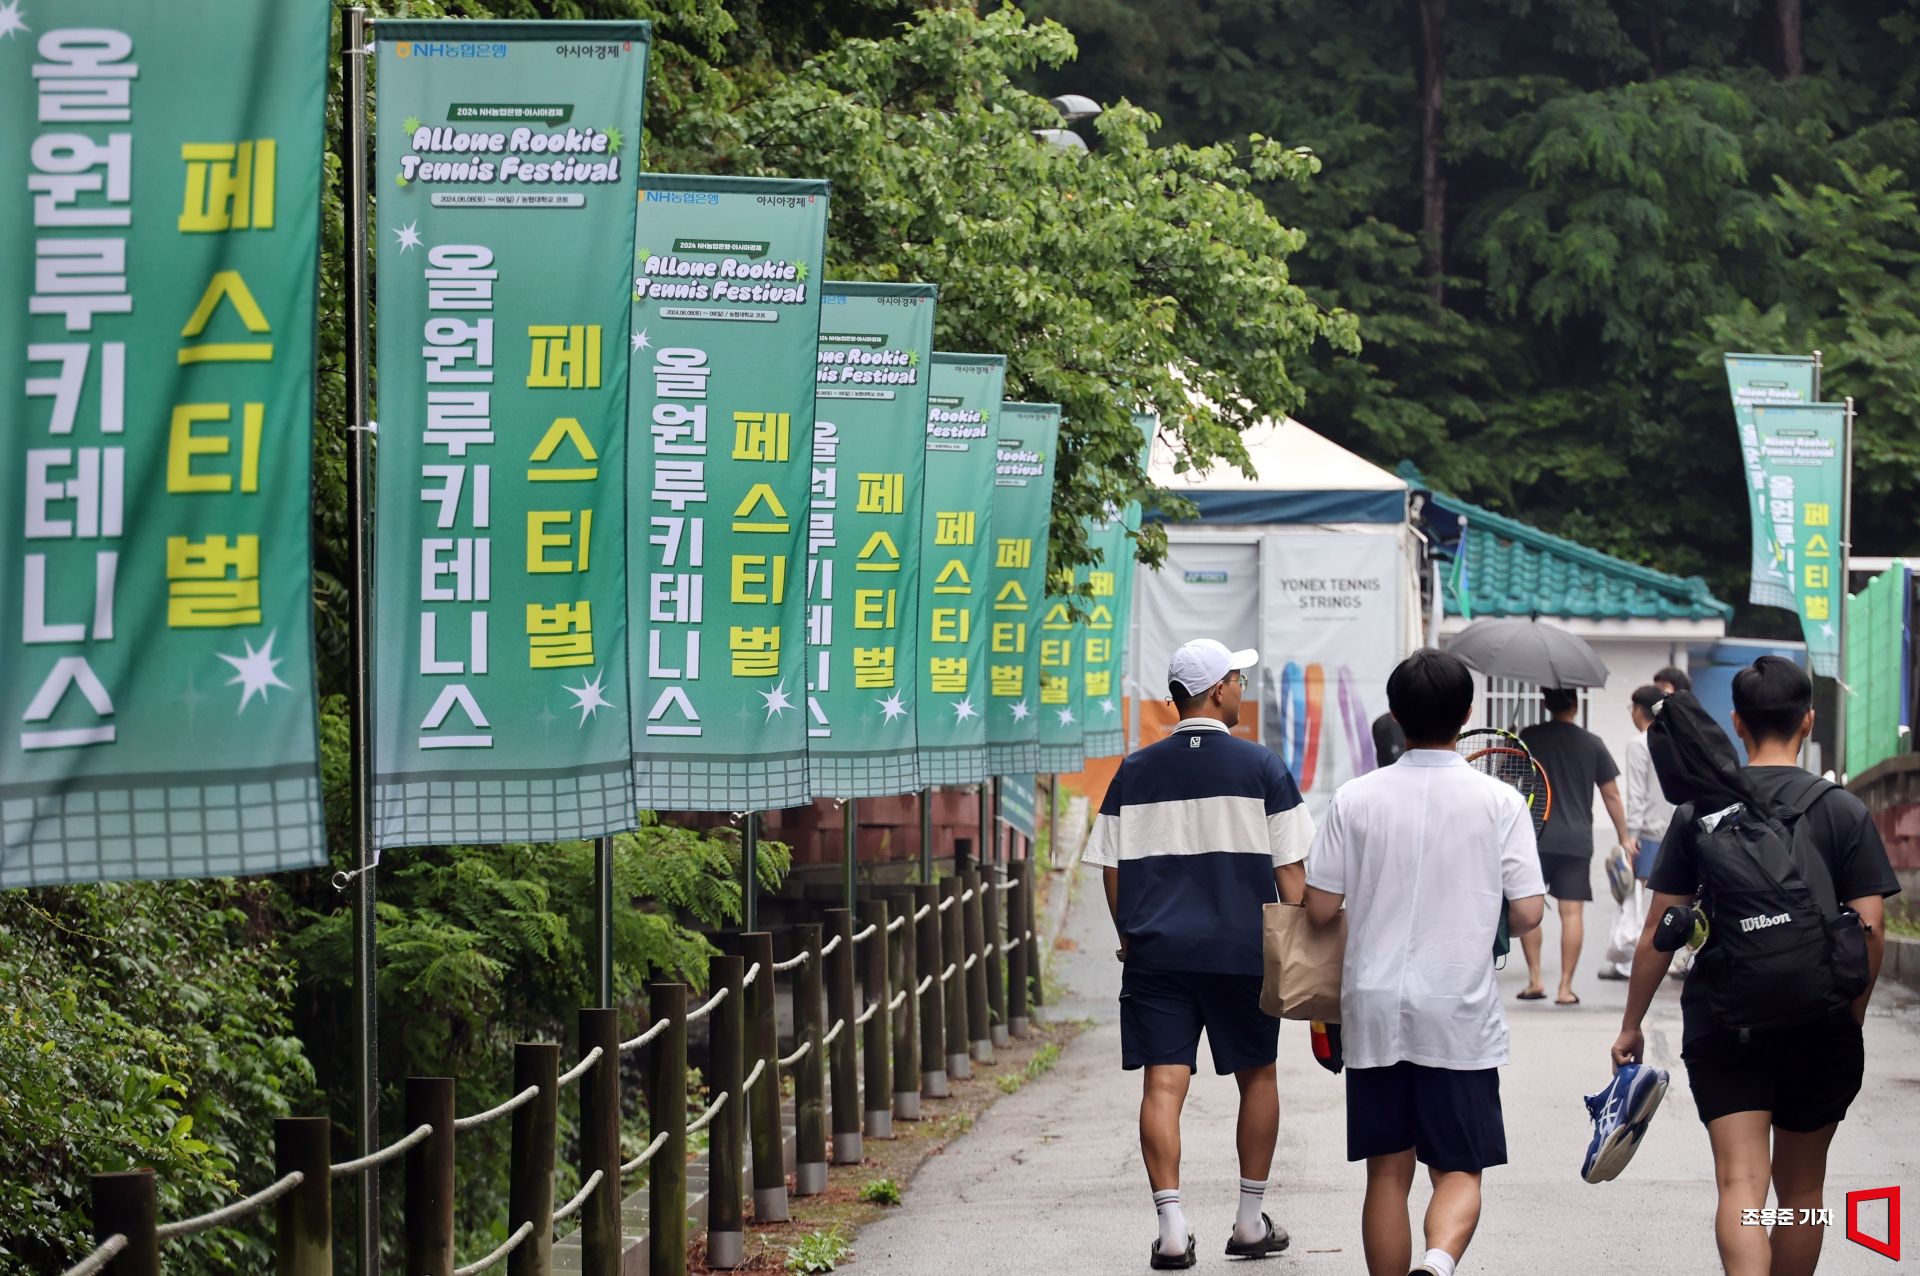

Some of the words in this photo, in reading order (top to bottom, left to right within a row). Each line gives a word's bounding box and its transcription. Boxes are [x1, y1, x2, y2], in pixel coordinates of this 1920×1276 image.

[414, 43, 507, 58] NH농협은행
[556, 45, 620, 60] 아시아경제
[457, 107, 478, 117] 2024
[411, 126, 507, 153] Allone
[509, 126, 610, 154] Rookie
[400, 155, 496, 182] Tennis
[499, 156, 621, 183] Festival
[646, 191, 720, 205] NH농협은행
[756, 196, 807, 208] 아시아경제
[644, 255, 718, 278] Allone
[720, 257, 797, 280] Rookie
[635, 277, 710, 301] Tennis
[712, 280, 806, 304] Festival
[847, 348, 910, 366] Rookie
[166, 139, 276, 627] 페스티벌
[840, 366, 917, 385] Festival
[20, 28, 139, 750] 올원루키테니스
[929, 408, 981, 424] Rookie
[926, 423, 988, 439] Festival
[996, 463, 1044, 477] estival
[419, 244, 498, 750] 올원루키테니스
[526, 325, 602, 669] 페스티벌
[646, 347, 711, 737] 올원루키테니스
[729, 411, 791, 677] 페스티벌
[854, 472, 905, 689] 페스티벌
[1280, 578, 1327, 591] YONEX
[1330, 578, 1381, 591] TENNIS
[931, 511, 976, 693] 페스티벌
[1299, 595, 1362, 609] STRINGS
[991, 538, 1032, 697] 페스티벌
[1739, 911, 1792, 933] Wilson
